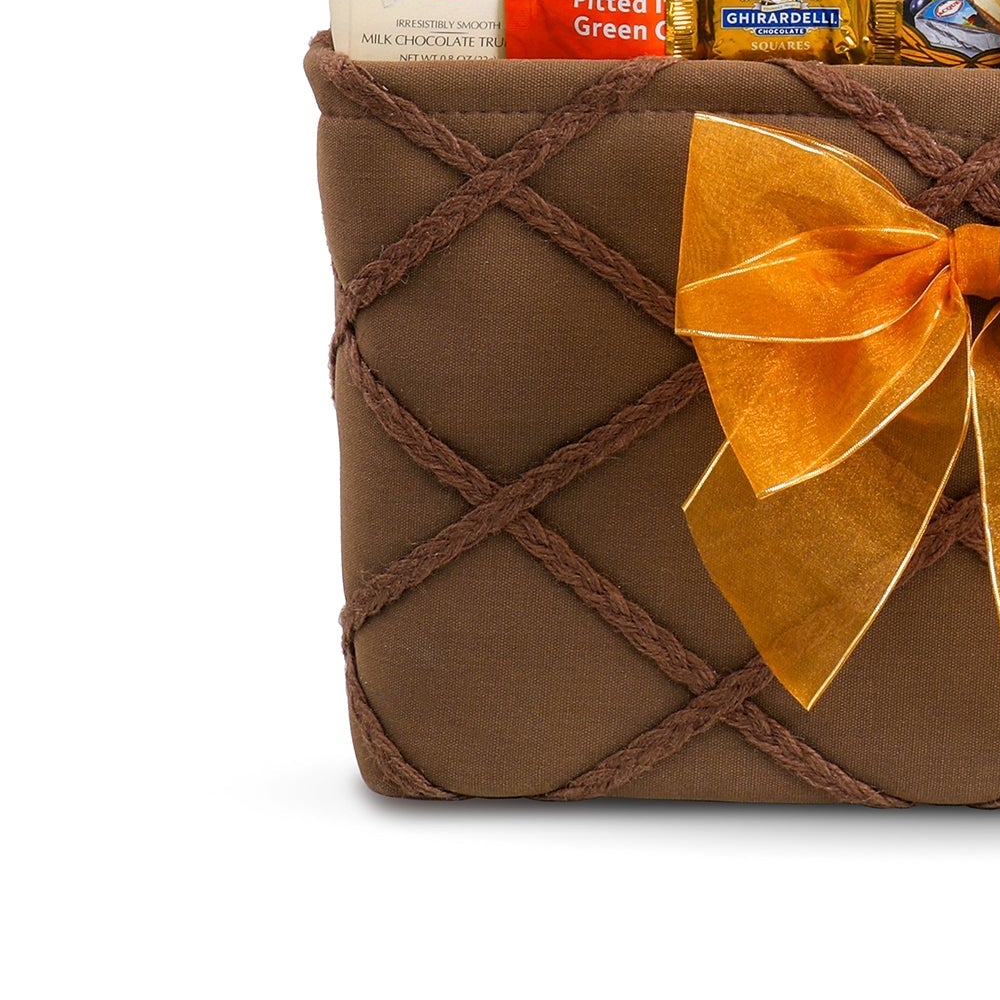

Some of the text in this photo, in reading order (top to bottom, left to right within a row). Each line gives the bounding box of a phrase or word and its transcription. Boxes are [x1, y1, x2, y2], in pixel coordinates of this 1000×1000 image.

[396, 19, 501, 30] IRRESISTIBLY SMOOTH
[574, 16, 647, 40] Green
[361, 33, 506, 48] MILK CHOCOLATE TRU
[751, 41, 811, 52] SQUARES
